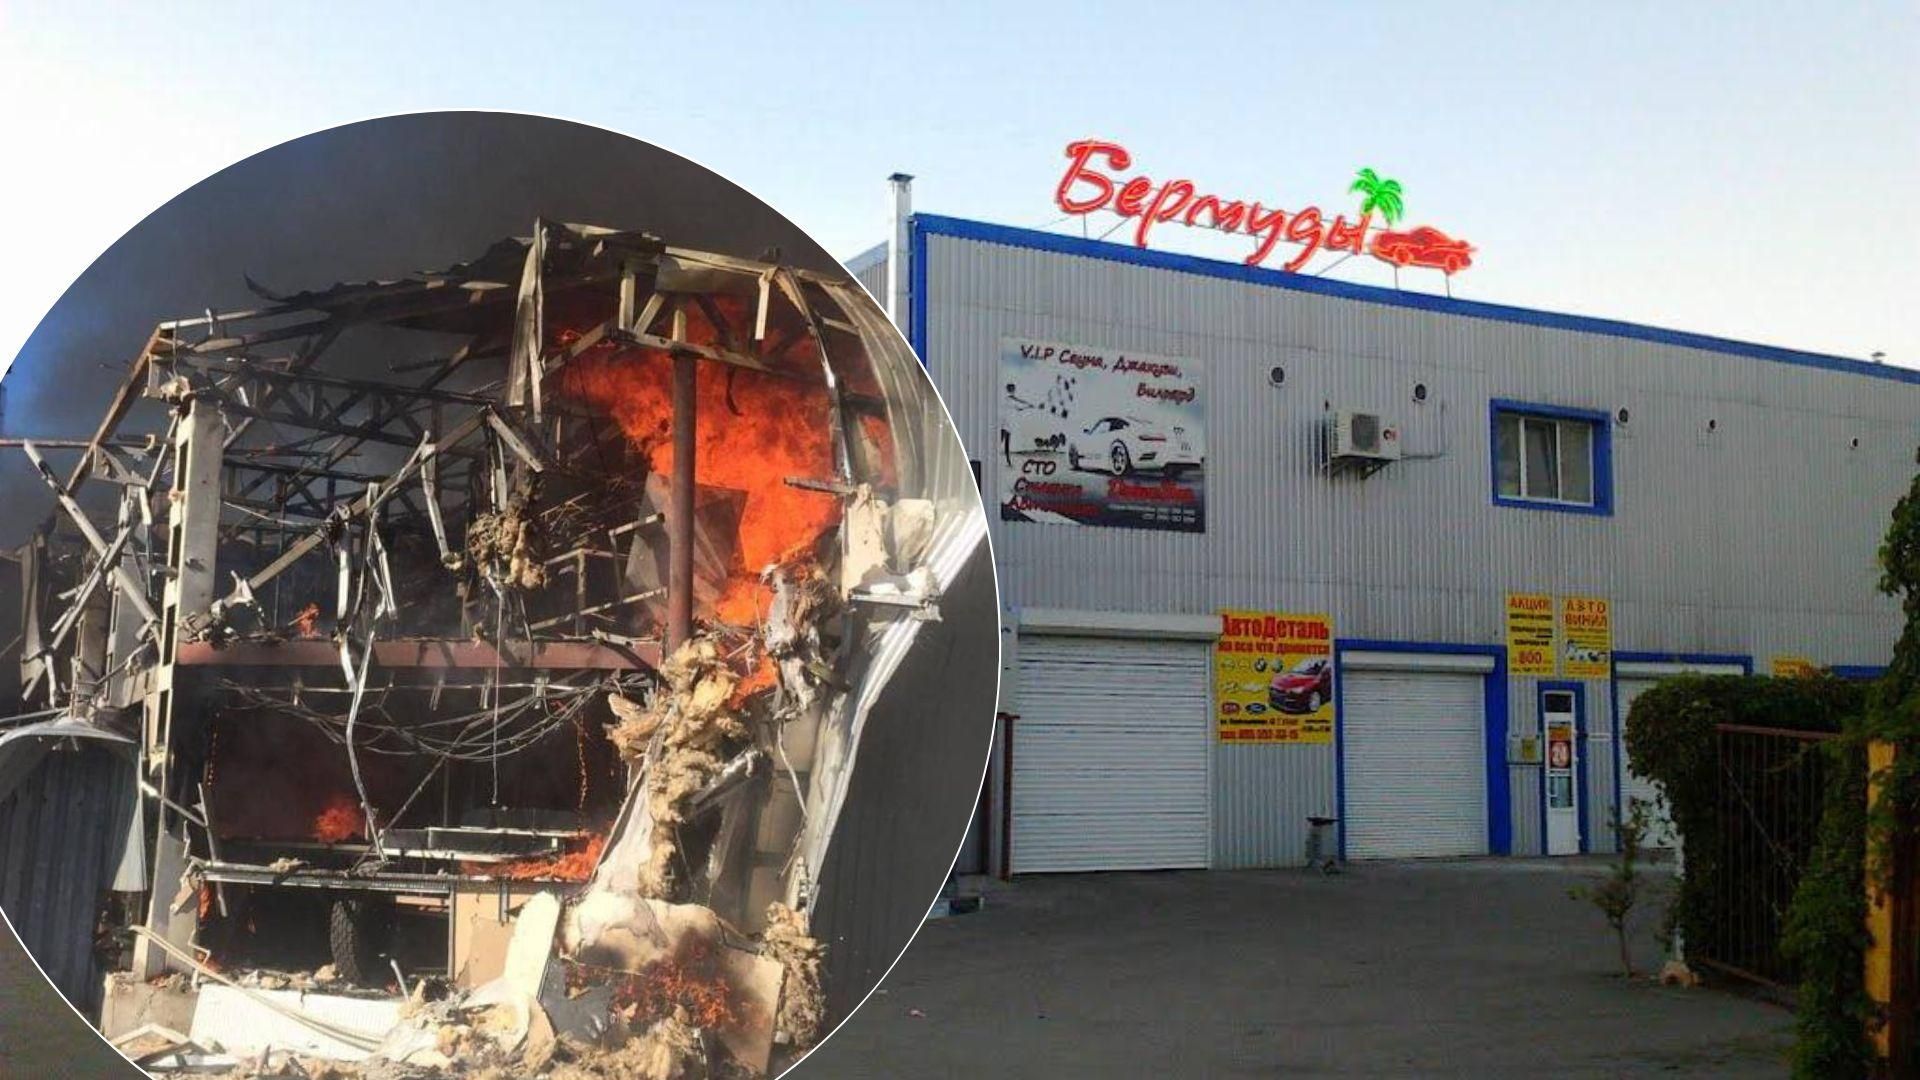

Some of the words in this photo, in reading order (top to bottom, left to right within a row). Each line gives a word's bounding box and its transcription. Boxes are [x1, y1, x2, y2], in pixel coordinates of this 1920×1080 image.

[1056, 139, 1373, 275] Бермуды
[1059, 349, 1108, 370] Сауна,
[1022, 459, 1057, 475] СТО
[1567, 600, 1606, 614] АВТО
